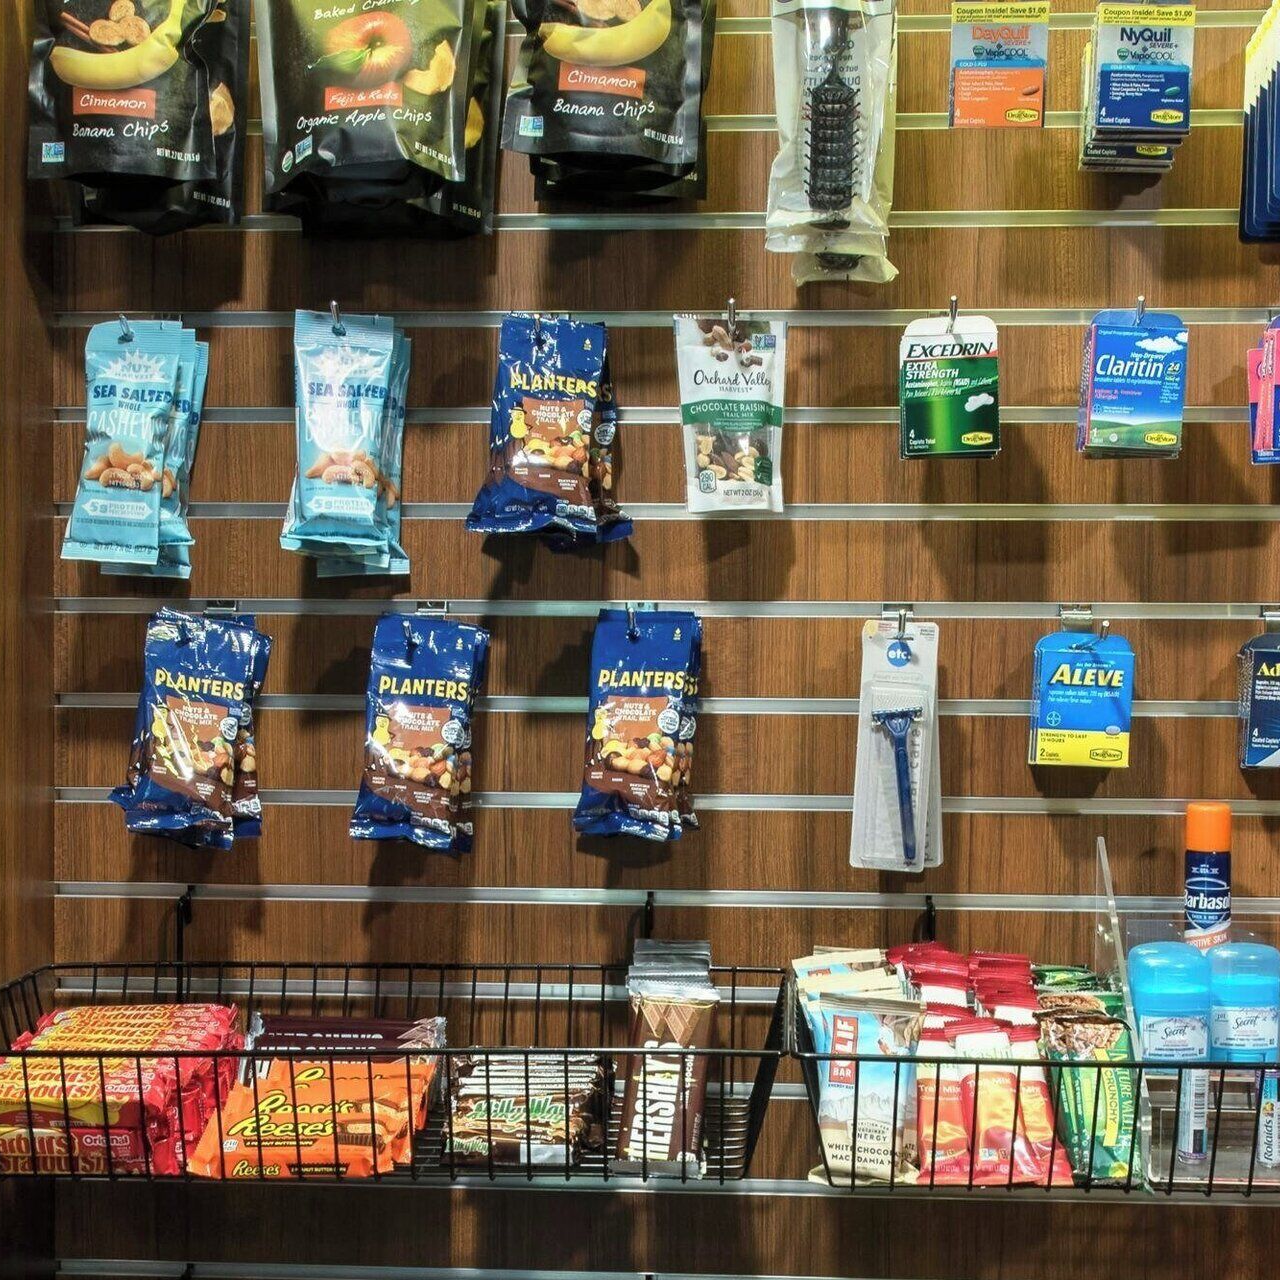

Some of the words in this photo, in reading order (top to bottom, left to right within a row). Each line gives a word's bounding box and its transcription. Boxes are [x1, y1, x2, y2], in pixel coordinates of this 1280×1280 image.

[313, 5, 355, 21] Baked
[1103, 8, 1130, 16] Coupon
[1120, 27, 1172, 45] NyQuil
[567, 70, 638, 89] Cinnamon
[80, 94, 147, 110] Cinnamon
[552, 98, 605, 117] Banana
[612, 101, 655, 121] Chips
[296, 114, 339, 134] Organic
[345, 109, 386, 126] Apple
[392, 109, 432, 126] Chips
[72, 123, 116, 138] Banana
[122, 120, 169, 141] Chips
[906, 342, 994, 359] EXCEDRIN
[905, 361, 938, 371] EXTRA
[905, 368, 959, 380] STRENGTH
[1096, 354, 1163, 378] Claritin
[1167, 362, 1180, 372] 24
[510, 370, 597, 398] PLANTERS
[693, 369, 741, 387] Orchard
[93, 384, 117, 399] SEA
[121, 386, 173, 404] SALTED
[307, 382, 334, 396] SEA
[337, 383, 387, 400] SALTED
[718, 385, 753, 393] HARVEST
[118, 400, 142, 412] WHOLE
[690, 401, 739, 415] CHOCOLATE
[909, 429, 915, 439] 4
[887, 647, 912, 660] etc.
[154, 667, 245, 701] PLANTERS
[598, 669, 686, 691] PLANTERS
[1049, 663, 1125, 688] ALEVE
[378, 675, 468, 701] PLANTERS
[1252, 728, 1259, 737] 4
[1040, 748, 1046, 757] 2
[1231, 1017, 1259, 1030] Secret
[1163, 1025, 1188, 1040] Secret
[831, 1066, 853, 1079] BAR
[1104, 1070, 1118, 1125] CRUNCHY
[228, 1114, 337, 1138] Reese's
[1261, 1117, 1274, 1162] Rolaids
